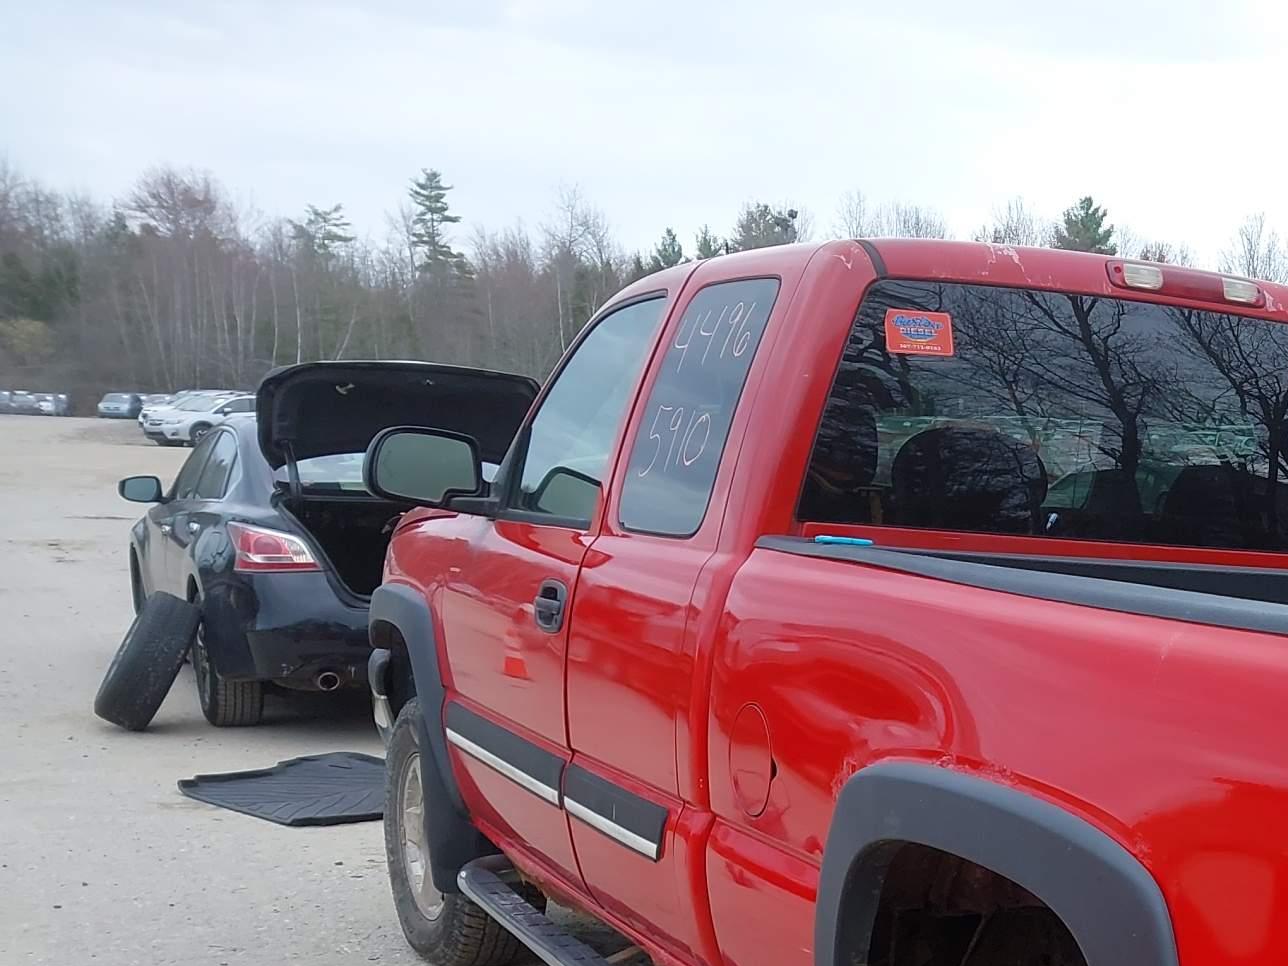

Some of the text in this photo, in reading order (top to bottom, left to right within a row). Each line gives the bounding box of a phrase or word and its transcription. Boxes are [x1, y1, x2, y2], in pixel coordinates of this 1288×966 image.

[674, 302, 757, 374] 4496
[900, 327, 938, 336] DIESEL
[638, 405, 711, 477] 5910
